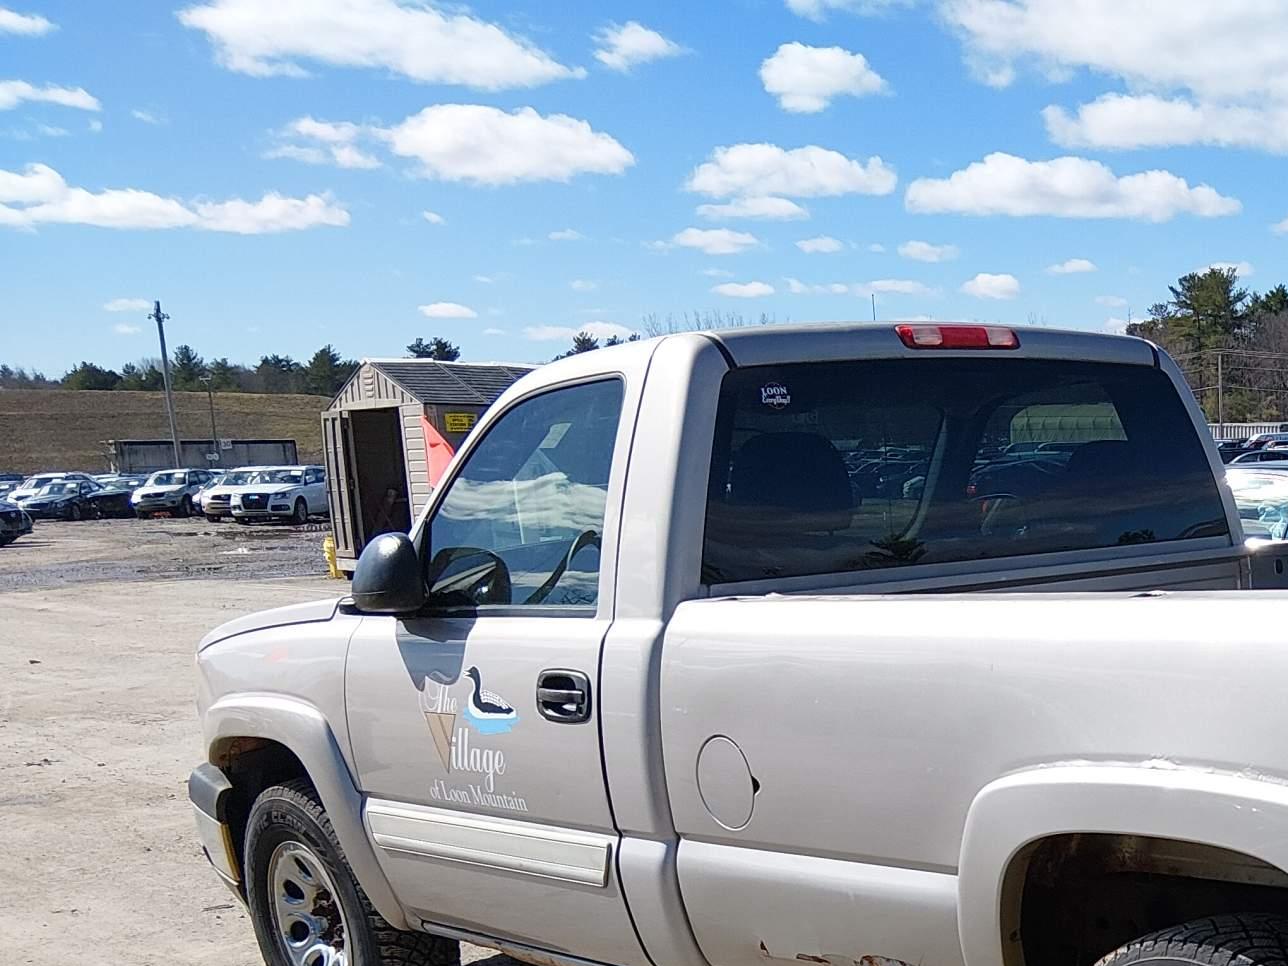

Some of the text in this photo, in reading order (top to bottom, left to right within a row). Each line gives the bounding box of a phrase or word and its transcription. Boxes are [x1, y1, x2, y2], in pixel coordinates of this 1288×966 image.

[760, 385, 788, 397] LOON
[430, 779, 529, 812] of Loon Mountain
